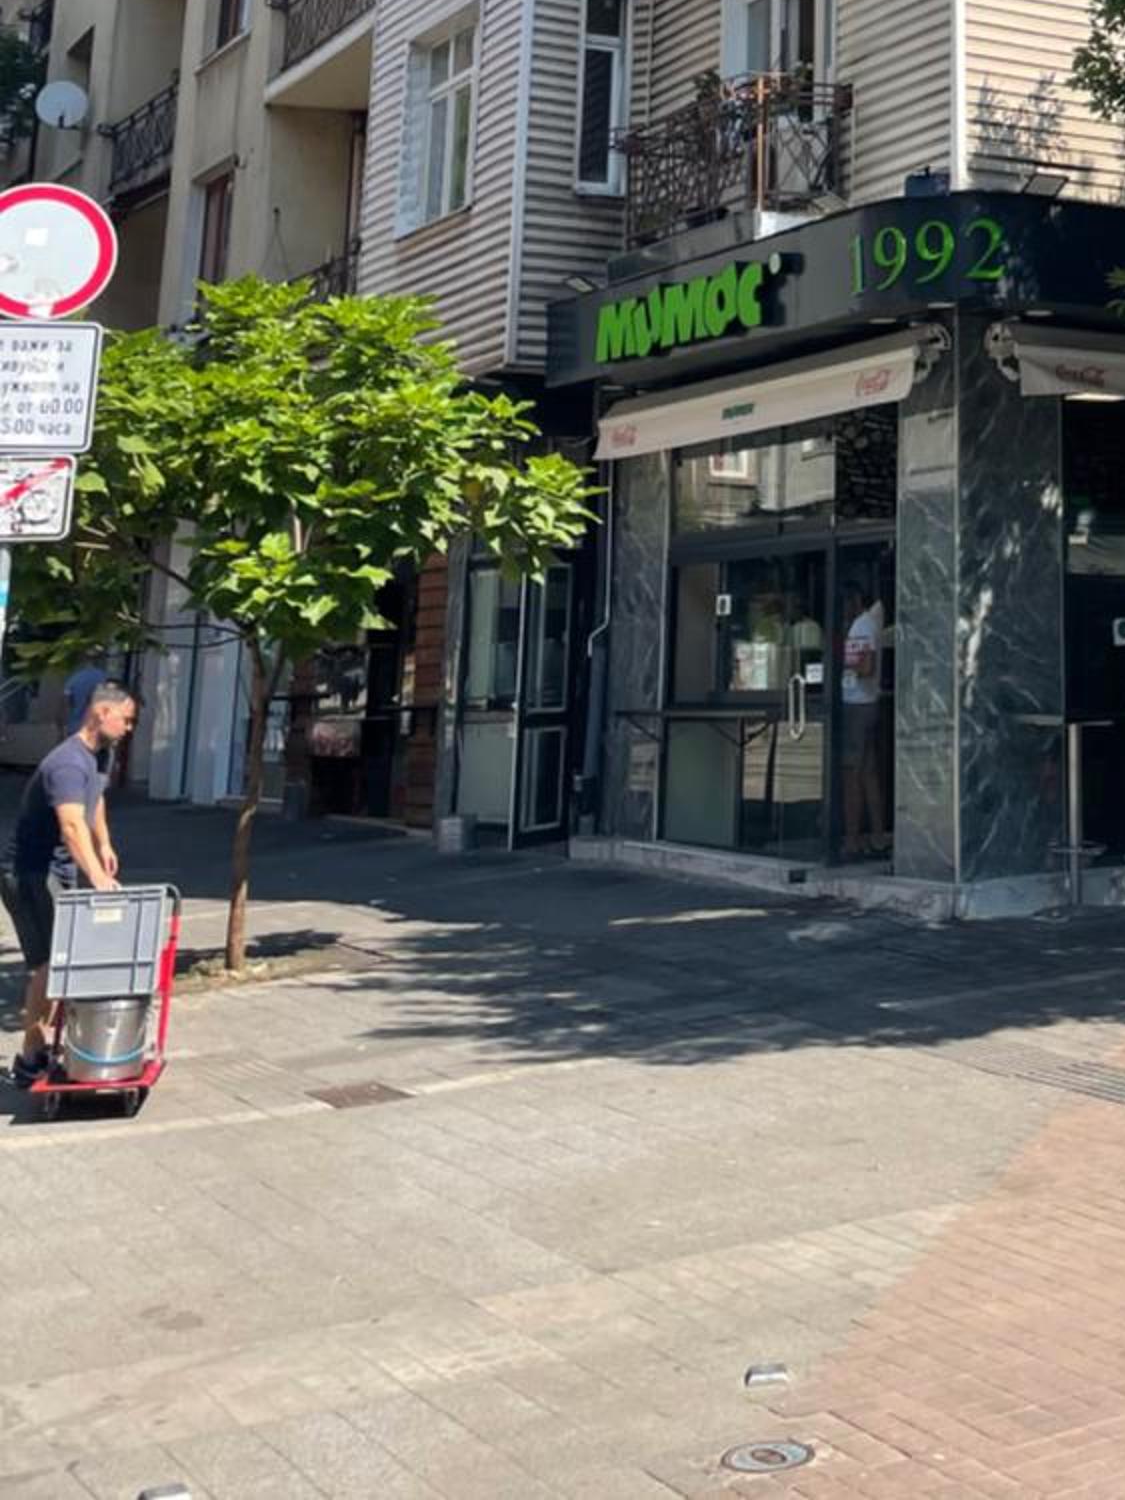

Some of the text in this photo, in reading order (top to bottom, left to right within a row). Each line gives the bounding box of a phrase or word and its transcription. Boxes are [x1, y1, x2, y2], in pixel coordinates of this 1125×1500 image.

[848, 217, 1006, 298] 1992
[17, 401, 33, 414] от
[0, 416, 72, 436] 5.00 часа
